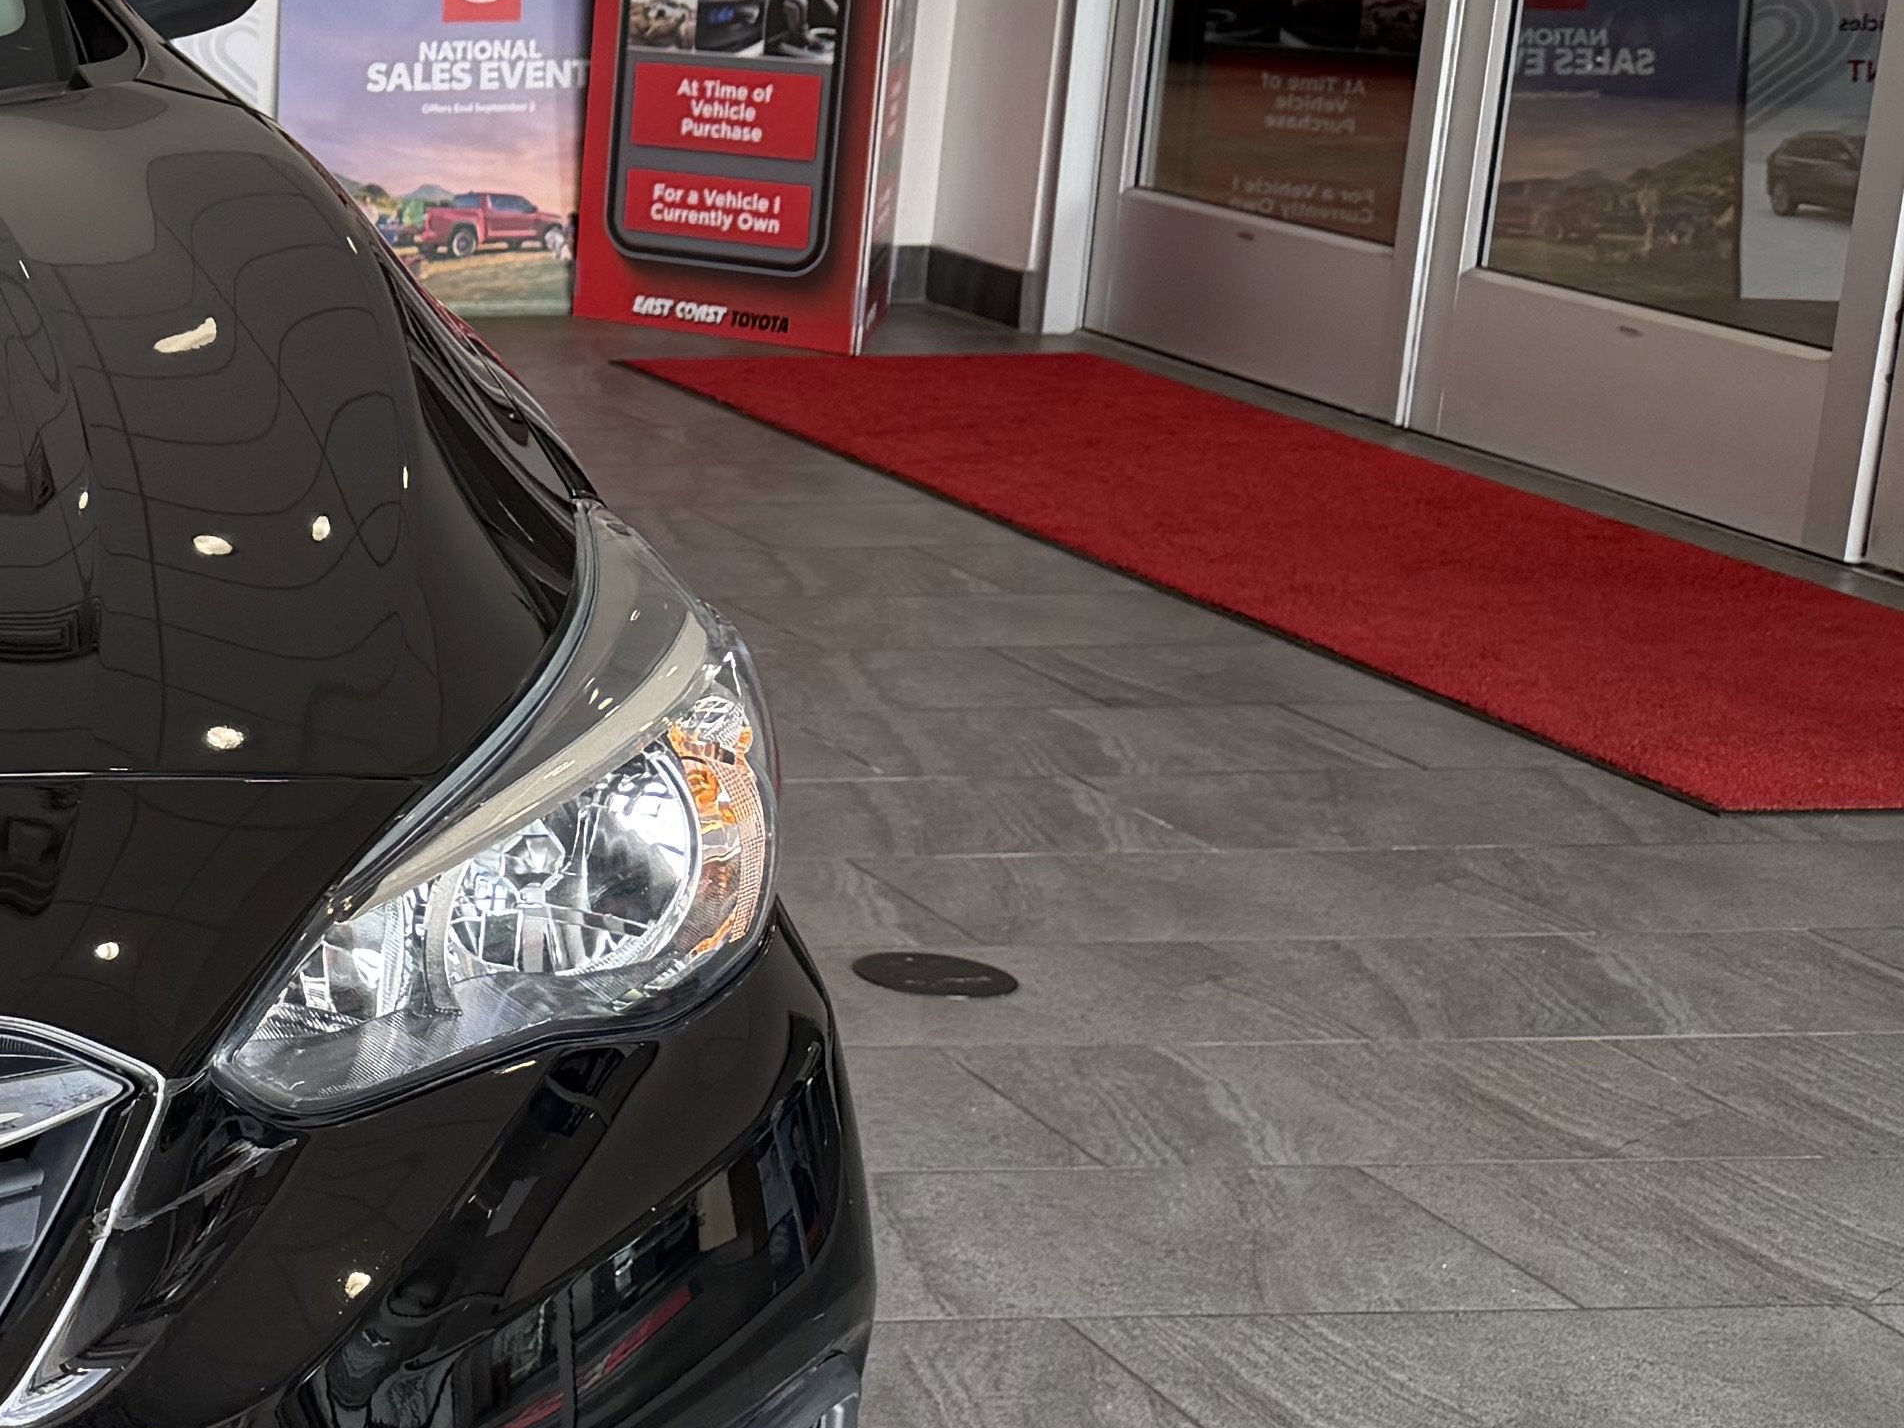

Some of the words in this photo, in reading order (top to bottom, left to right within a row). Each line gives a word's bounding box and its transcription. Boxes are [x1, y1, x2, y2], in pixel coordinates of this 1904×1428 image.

[419, 40, 541, 62] NATIONAL
[366, 60, 472, 93] SALES
[479, 59, 590, 90] EVENT
[677, 78, 699, 97] At
[705, 80, 749, 100] Time
[752, 83, 774, 103] of
[691, 97, 756, 121] Vehicle
[681, 119, 762, 143] Purchase
[653, 182, 683, 204] For
[686, 191, 699, 205] a
[703, 187, 769, 210] Vehicle
[650, 202, 733, 231] Currently
[736, 214, 780, 235] Own
[632, 295, 674, 319] EAST
[675, 301, 728, 326] COAST
[731, 310, 789, 334] TOYOTA
